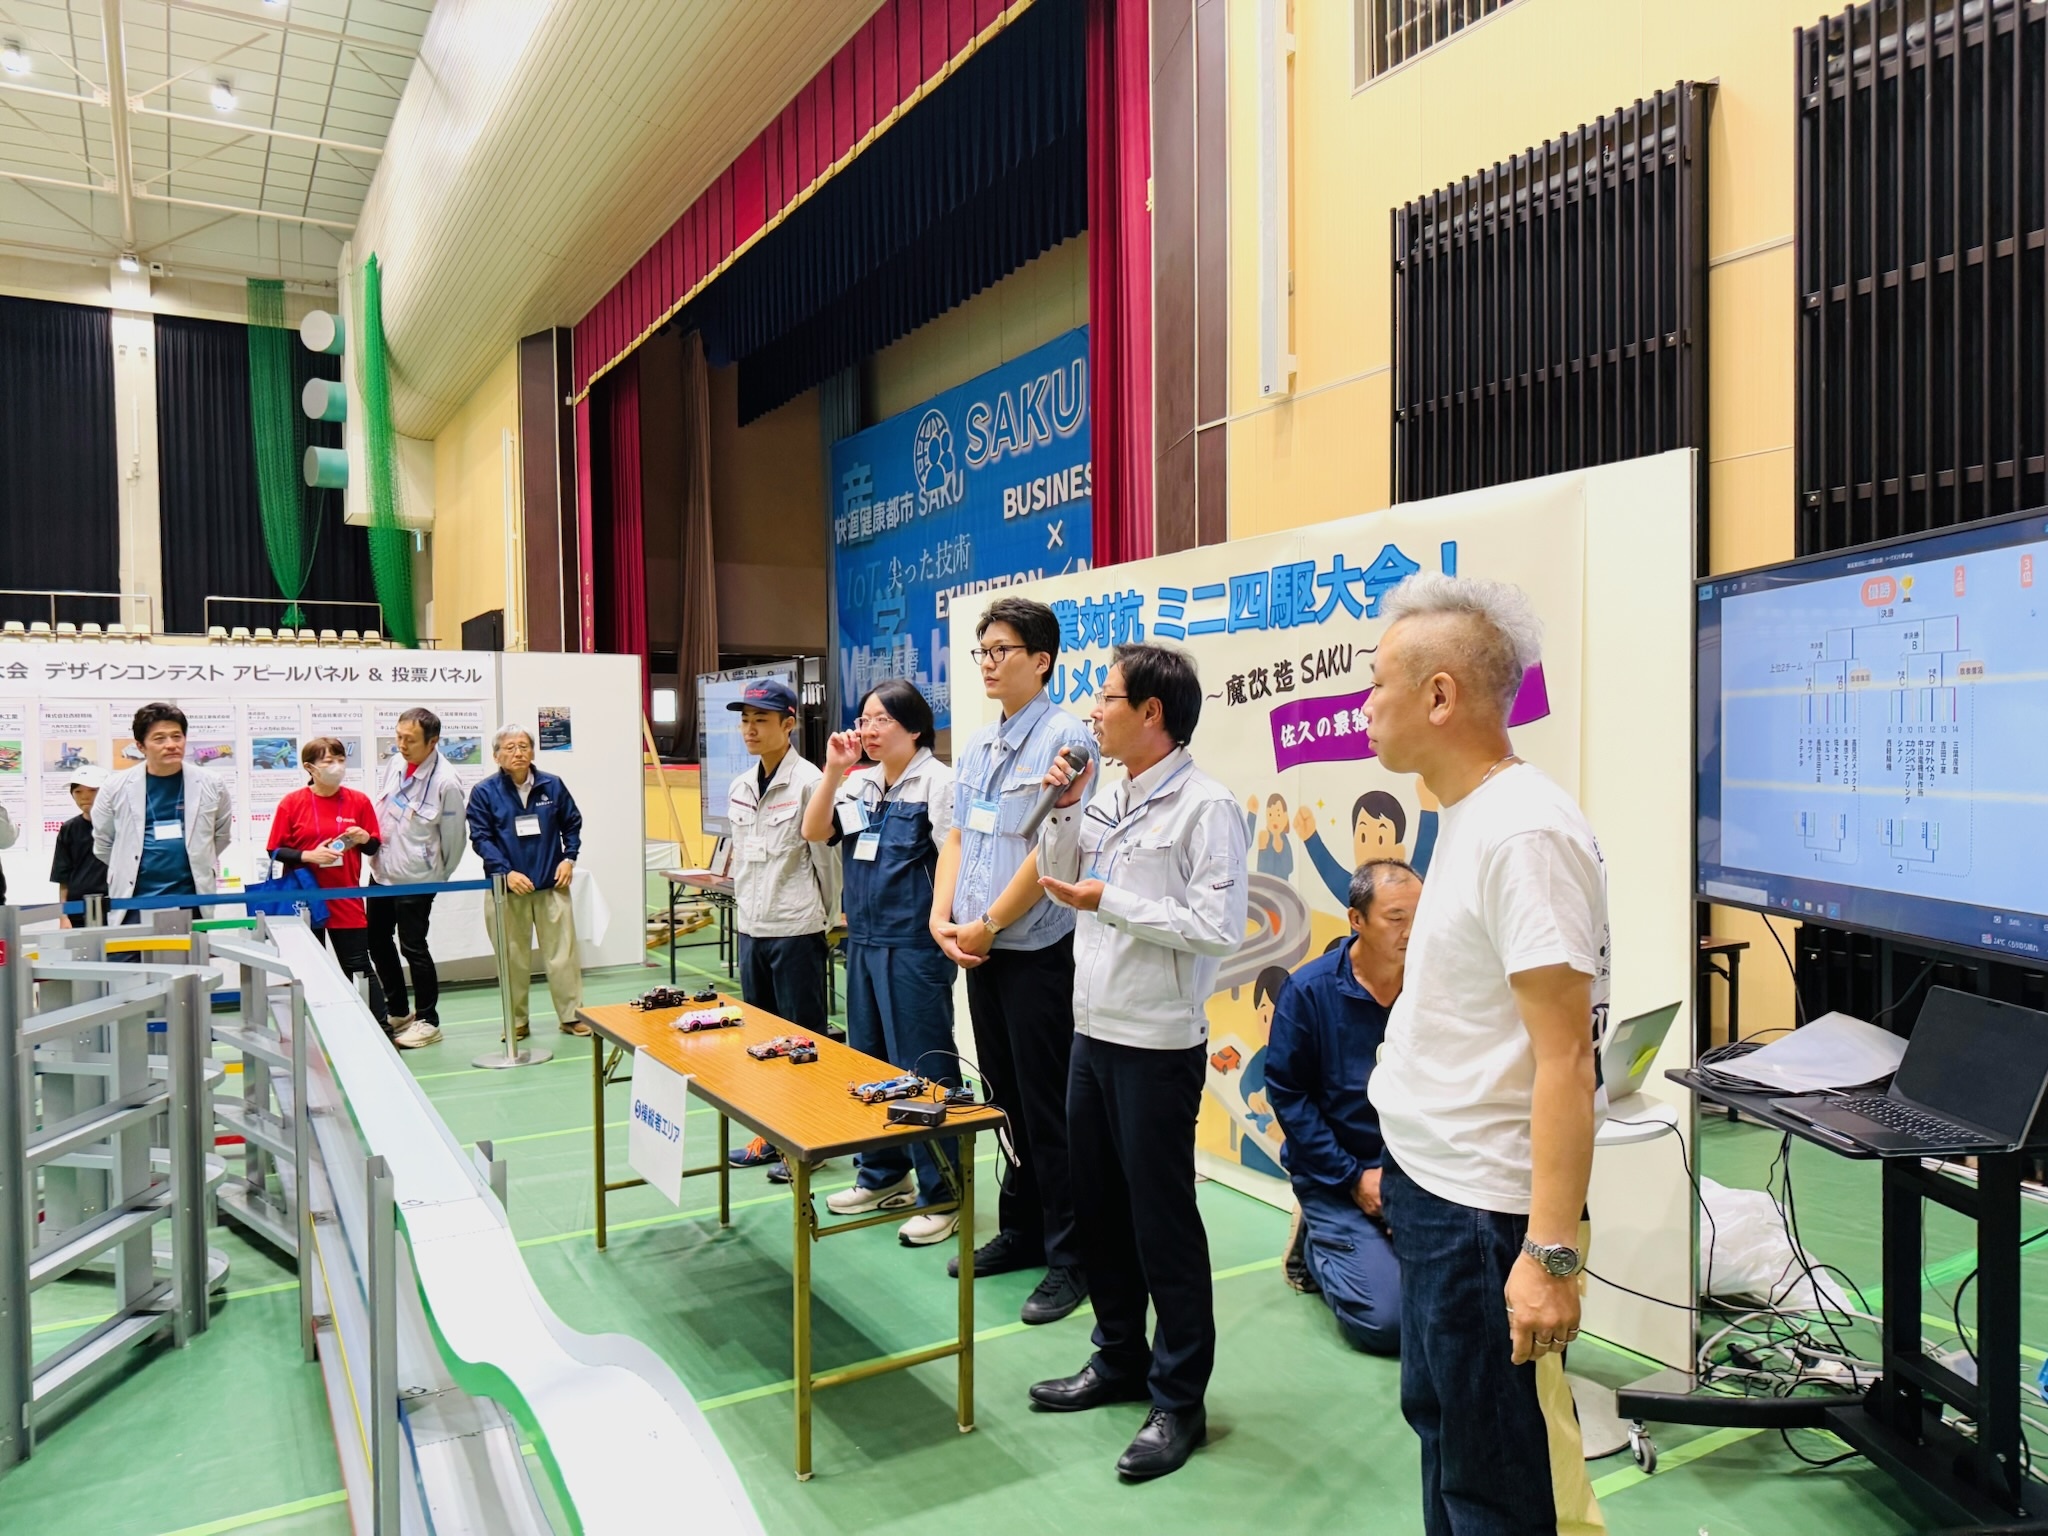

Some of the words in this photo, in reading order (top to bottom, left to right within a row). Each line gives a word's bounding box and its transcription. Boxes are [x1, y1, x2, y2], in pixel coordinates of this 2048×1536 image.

[964, 358, 1084, 464] SAKU
[834, 490, 914, 545] 快適健康都市
[918, 469, 964, 517] SAKU
[888, 533, 971, 592] 尖った技術
[2022, 560, 2033, 582] 3位
[1867, 582, 1891, 600] 優勝
[1050, 589, 1145, 652] 業対抗
[1911, 641, 1918, 651] B
[1817, 650, 1823, 660] A
[45, 661, 224, 681] デザインコンテスト
[233, 664, 359, 682] アピールパネル
[368, 667, 383, 682] &
[392, 667, 483, 684] 投票パネル
[1769, 662, 1804, 674] 上位2チーム
[1899, 677, 1906, 686] C
[1928, 675, 1936, 684] D
[1806, 683, 1813, 691] A
[1838, 681, 1844, 690] B
[1814, 853, 1818, 861] 1
[1897, 865, 1903, 874] 2
